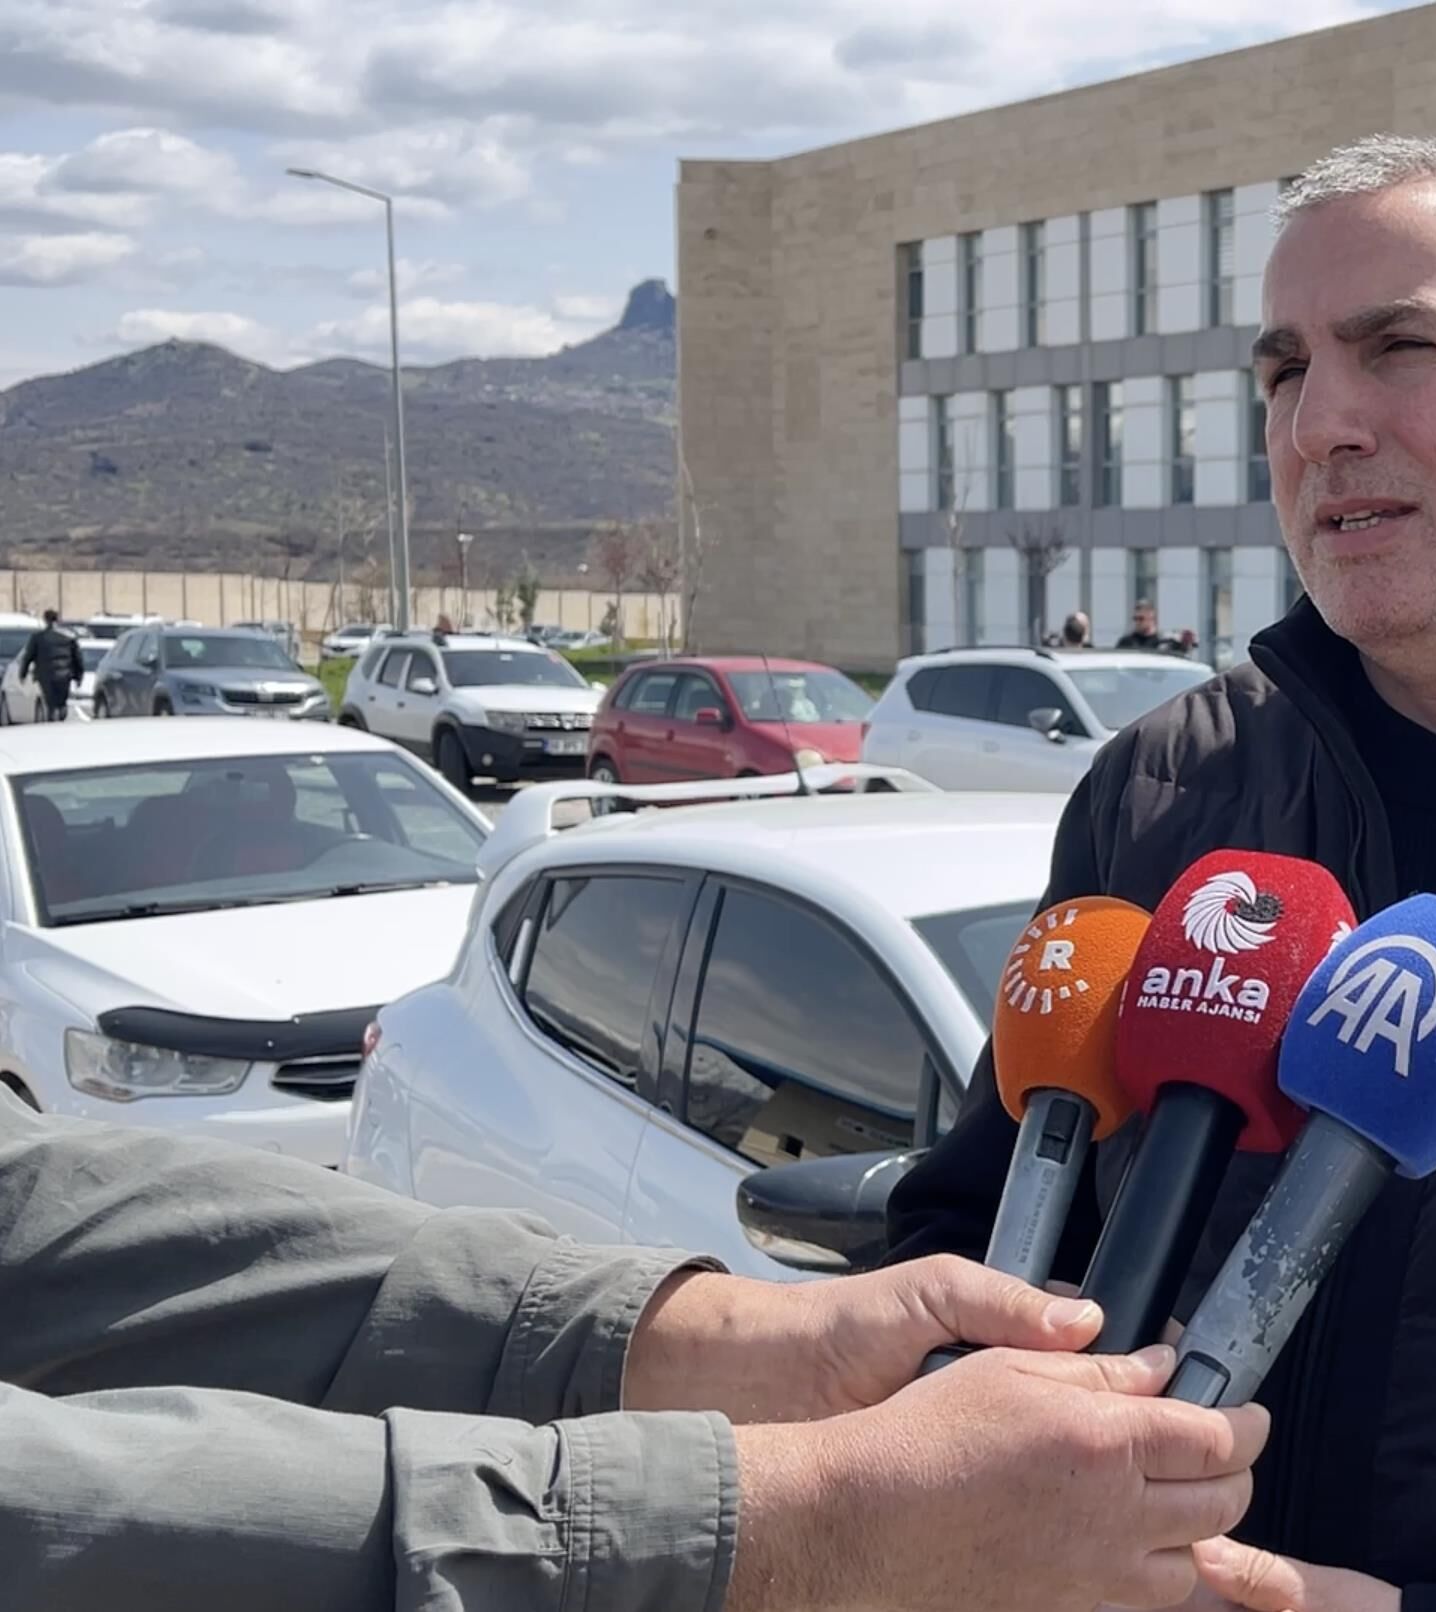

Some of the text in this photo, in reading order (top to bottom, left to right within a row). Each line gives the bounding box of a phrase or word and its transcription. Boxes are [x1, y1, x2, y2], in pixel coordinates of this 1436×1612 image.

[1040, 940, 1075, 970] R
[1142, 956, 1270, 1010] anka
[1137, 996, 1261, 1024] HABER AJANSI
[1306, 957, 1423, 1077] AA
